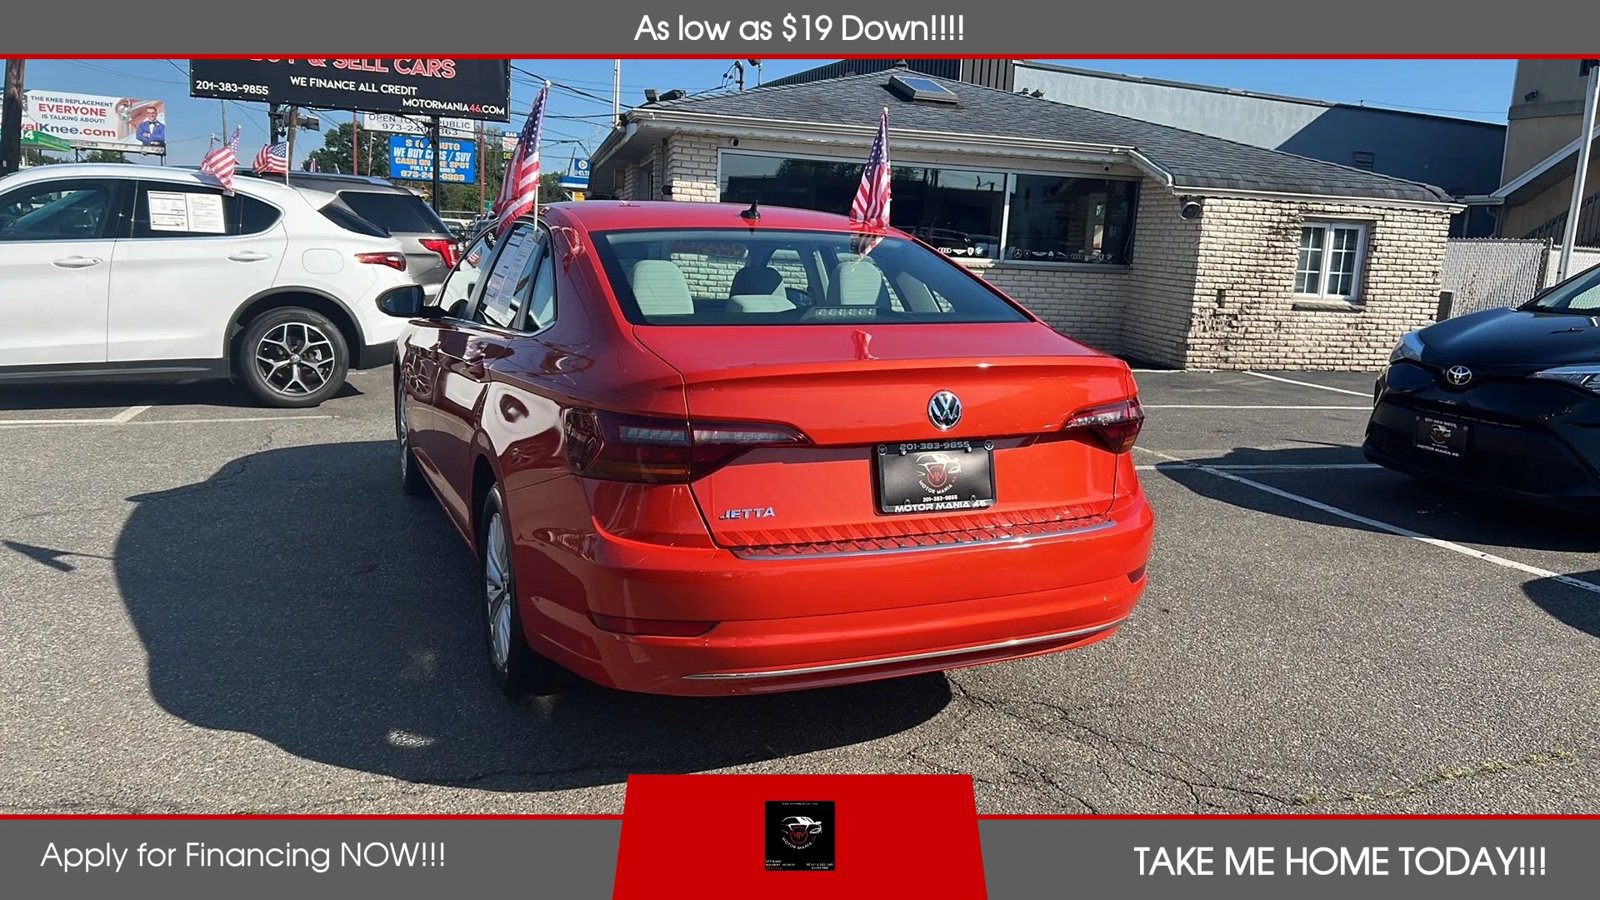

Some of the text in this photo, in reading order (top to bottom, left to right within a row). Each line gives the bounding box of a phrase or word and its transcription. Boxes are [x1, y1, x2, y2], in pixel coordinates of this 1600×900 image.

[394, 59, 456, 79] CARS
[195, 80, 269, 96] 201-383-9855
[290, 75, 418, 96] WE FINANCE ALL CREDIT
[45, 96, 64, 104] KNEE
[65, 97, 114, 108] REPLACEMENT
[402, 97, 505, 115] MOTORMANIA46.COM
[38, 103, 107, 117] EVERYONE
[50, 114, 78, 122] TALKING
[80, 116, 106, 124] ABOUT!
[369, 113, 396, 123] OPEN
[393, 146, 407, 158] WE
[407, 148, 424, 159] BUY
[455, 152, 472, 163] SUV
[900, 440, 970, 451] 201-383-9855
[919, 479, 936, 494] MOTOR
[936, 484, 953, 494] MANIA
[895, 499, 988, 513] MOTOR MANIA 46
[719, 507, 776, 520] JETTA
